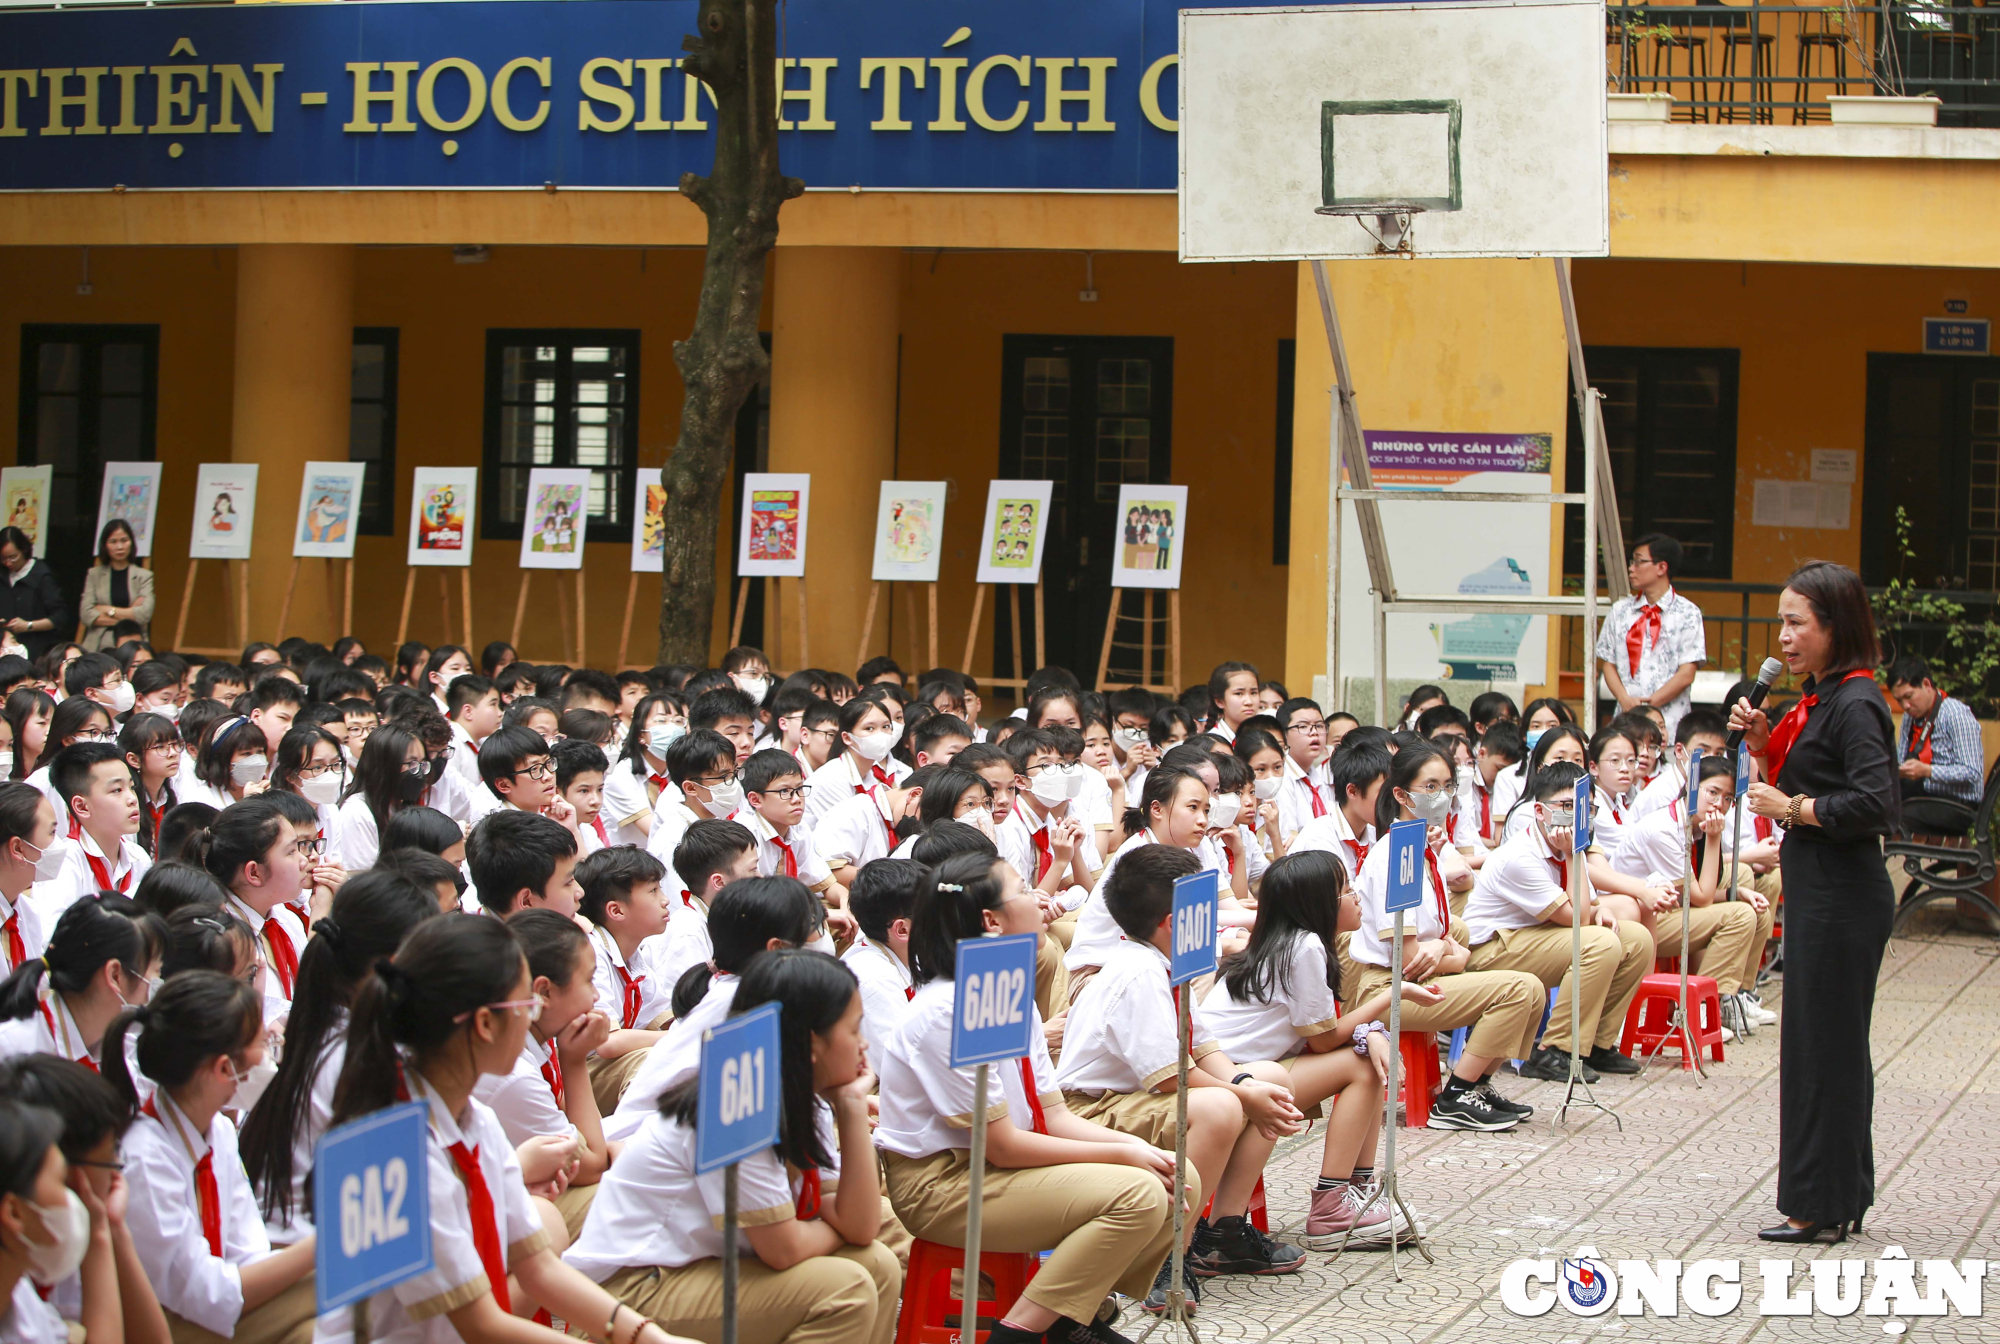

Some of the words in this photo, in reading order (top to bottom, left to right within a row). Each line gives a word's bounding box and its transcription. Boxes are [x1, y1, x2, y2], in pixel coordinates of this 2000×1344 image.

[0, 37, 284, 158] THIỆN
[301, 92, 328, 105] -
[343, 57, 552, 157] HỌC
[860, 26, 1117, 131] TÍCH
[1372, 441, 1425, 452] NHỮNG
[1428, 443, 1459, 455] VIỆC
[1400, 844, 1414, 886] 6A
[1176, 900, 1212, 957] 6A01
[963, 966, 1026, 1032] 6A02
[719, 1048, 765, 1126] 6A1
[339, 1156, 410, 1259] 6A2
